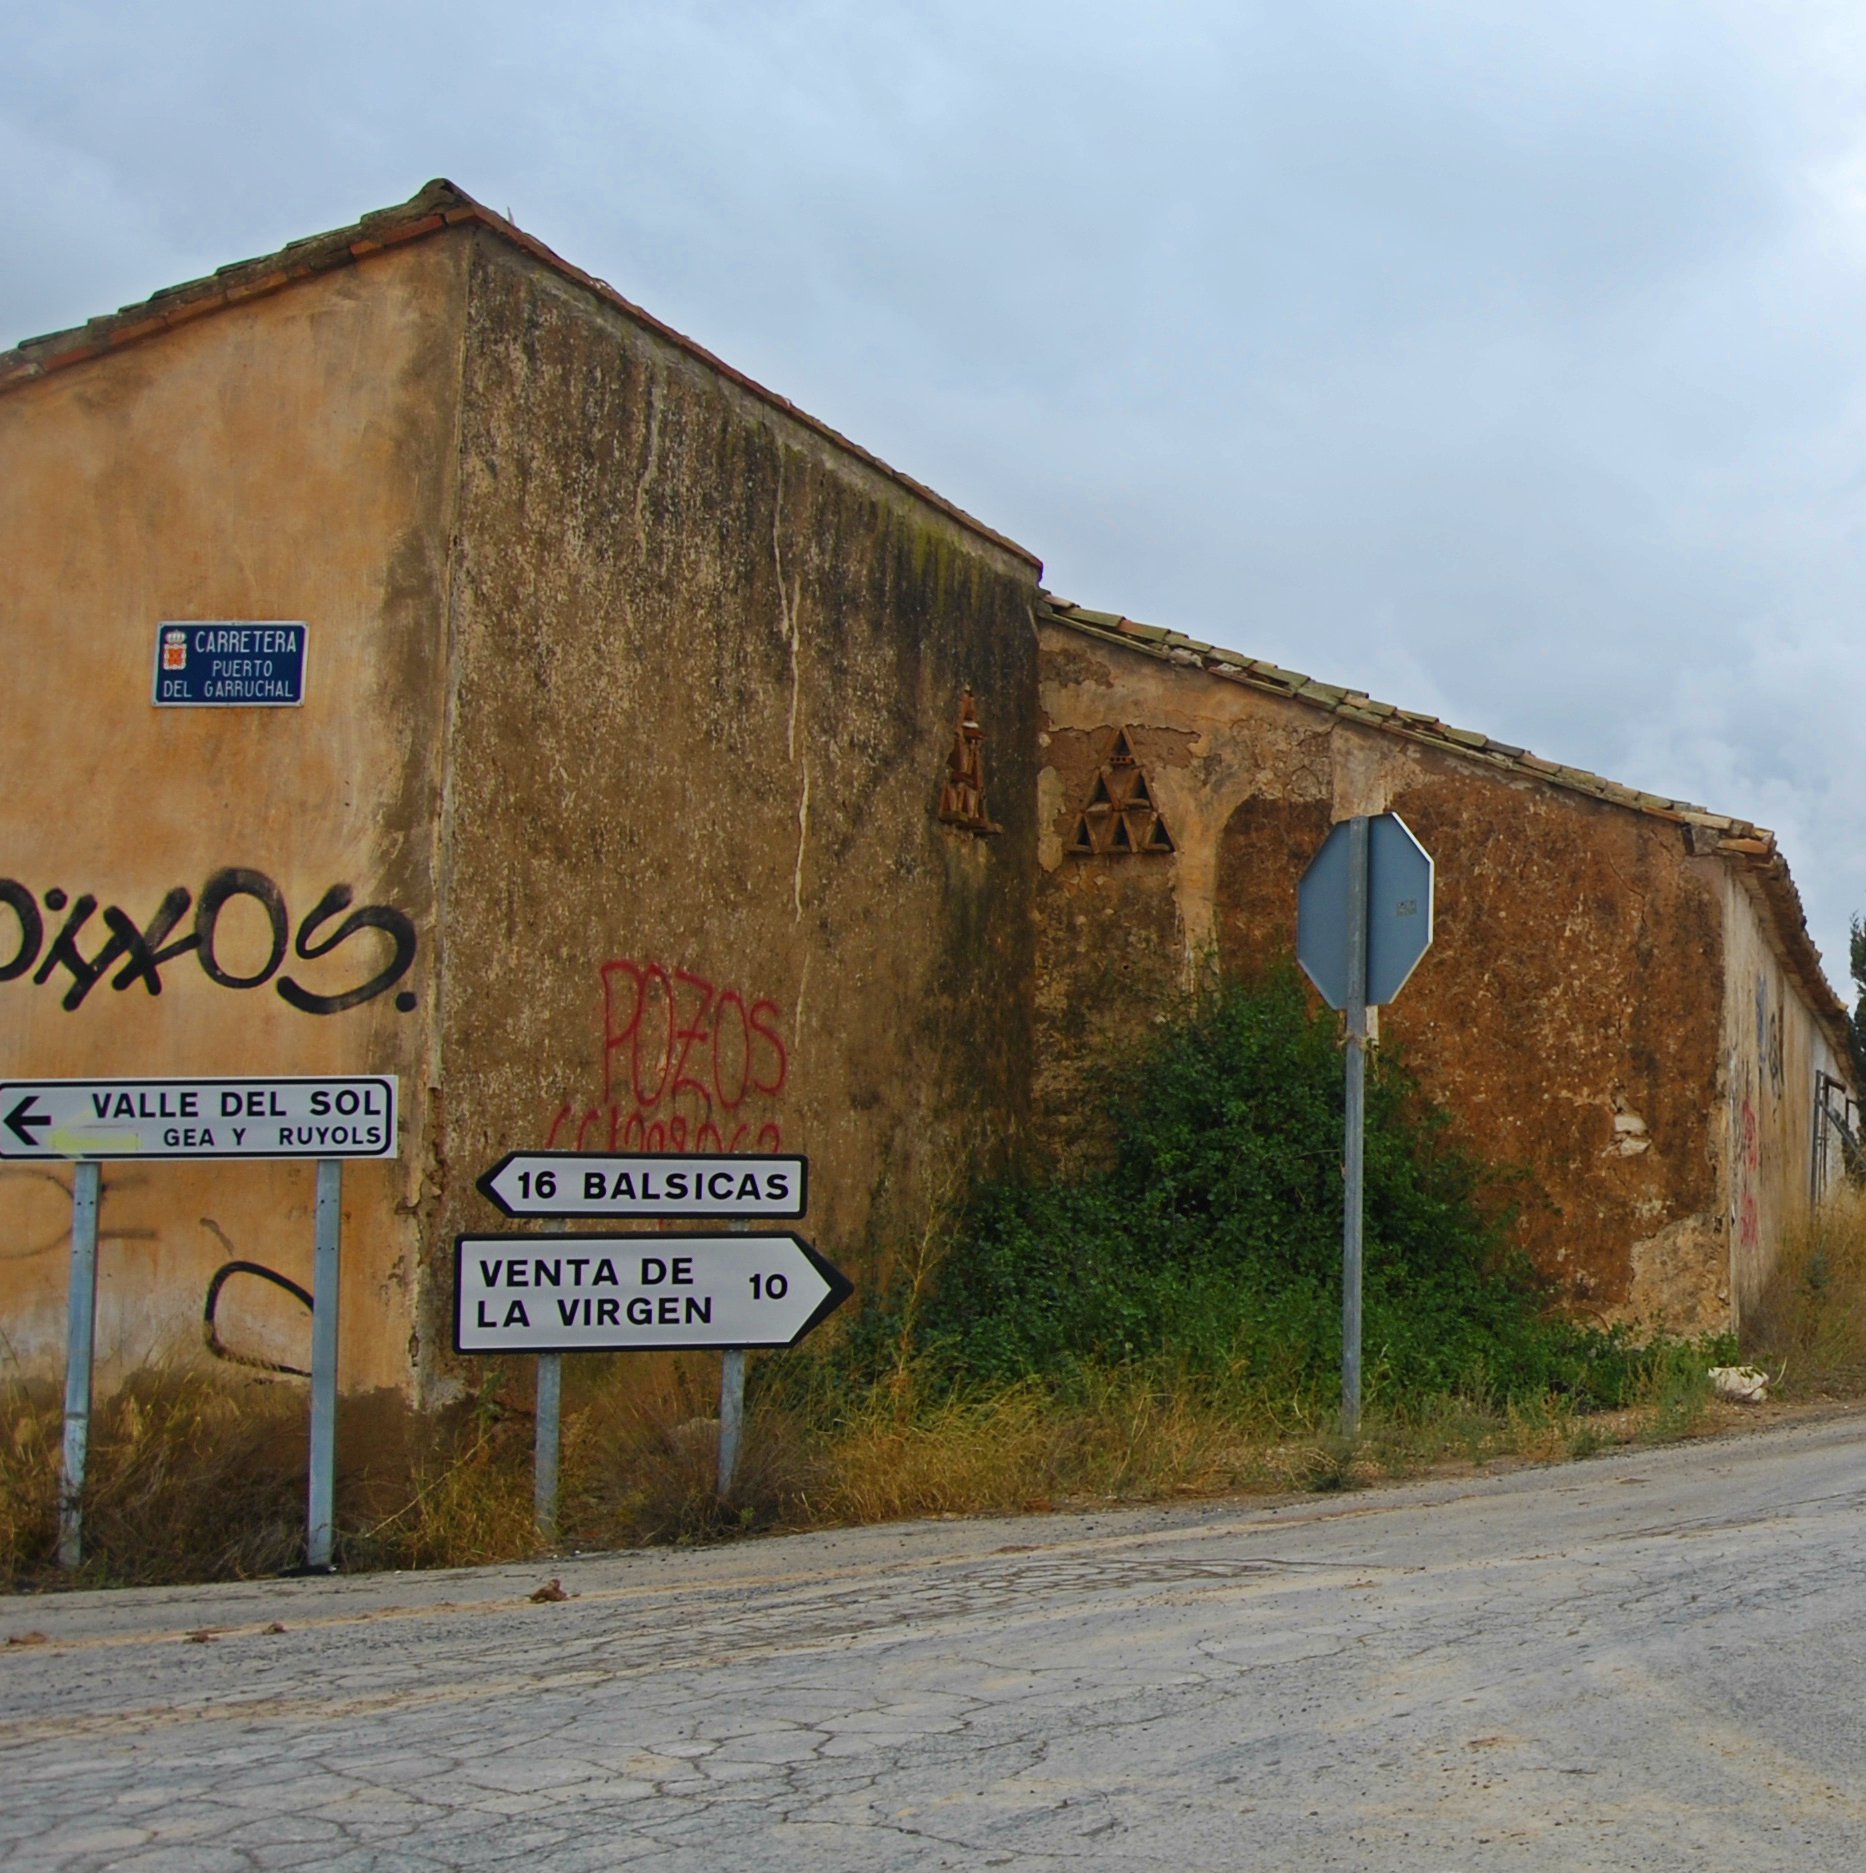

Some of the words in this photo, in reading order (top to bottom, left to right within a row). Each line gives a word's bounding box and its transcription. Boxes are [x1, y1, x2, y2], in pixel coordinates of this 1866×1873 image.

[195, 630, 297, 653] CARRETERA
[212, 660, 273, 677] PUERTO
[163, 680, 192, 697] DEL
[204, 680, 294, 697] GARRUCHAL
[601, 959, 787, 1111] POZOS
[92, 1092, 199, 1119] VALLE
[220, 1091, 287, 1117] DEL
[309, 1089, 381, 1116] SOL
[163, 1128, 215, 1147] GEA
[232, 1127, 247, 1145] Y
[278, 1126, 382, 1145] RUYOLS
[518, 1171, 557, 1199] 16
[584, 1172, 789, 1200] BALSICAS
[479, 1259, 619, 1287] VENTA
[641, 1257, 694, 1285] DE
[749, 1273, 788, 1300] 10
[477, 1300, 530, 1328] LA
[557, 1297, 712, 1326] VIRGEN
